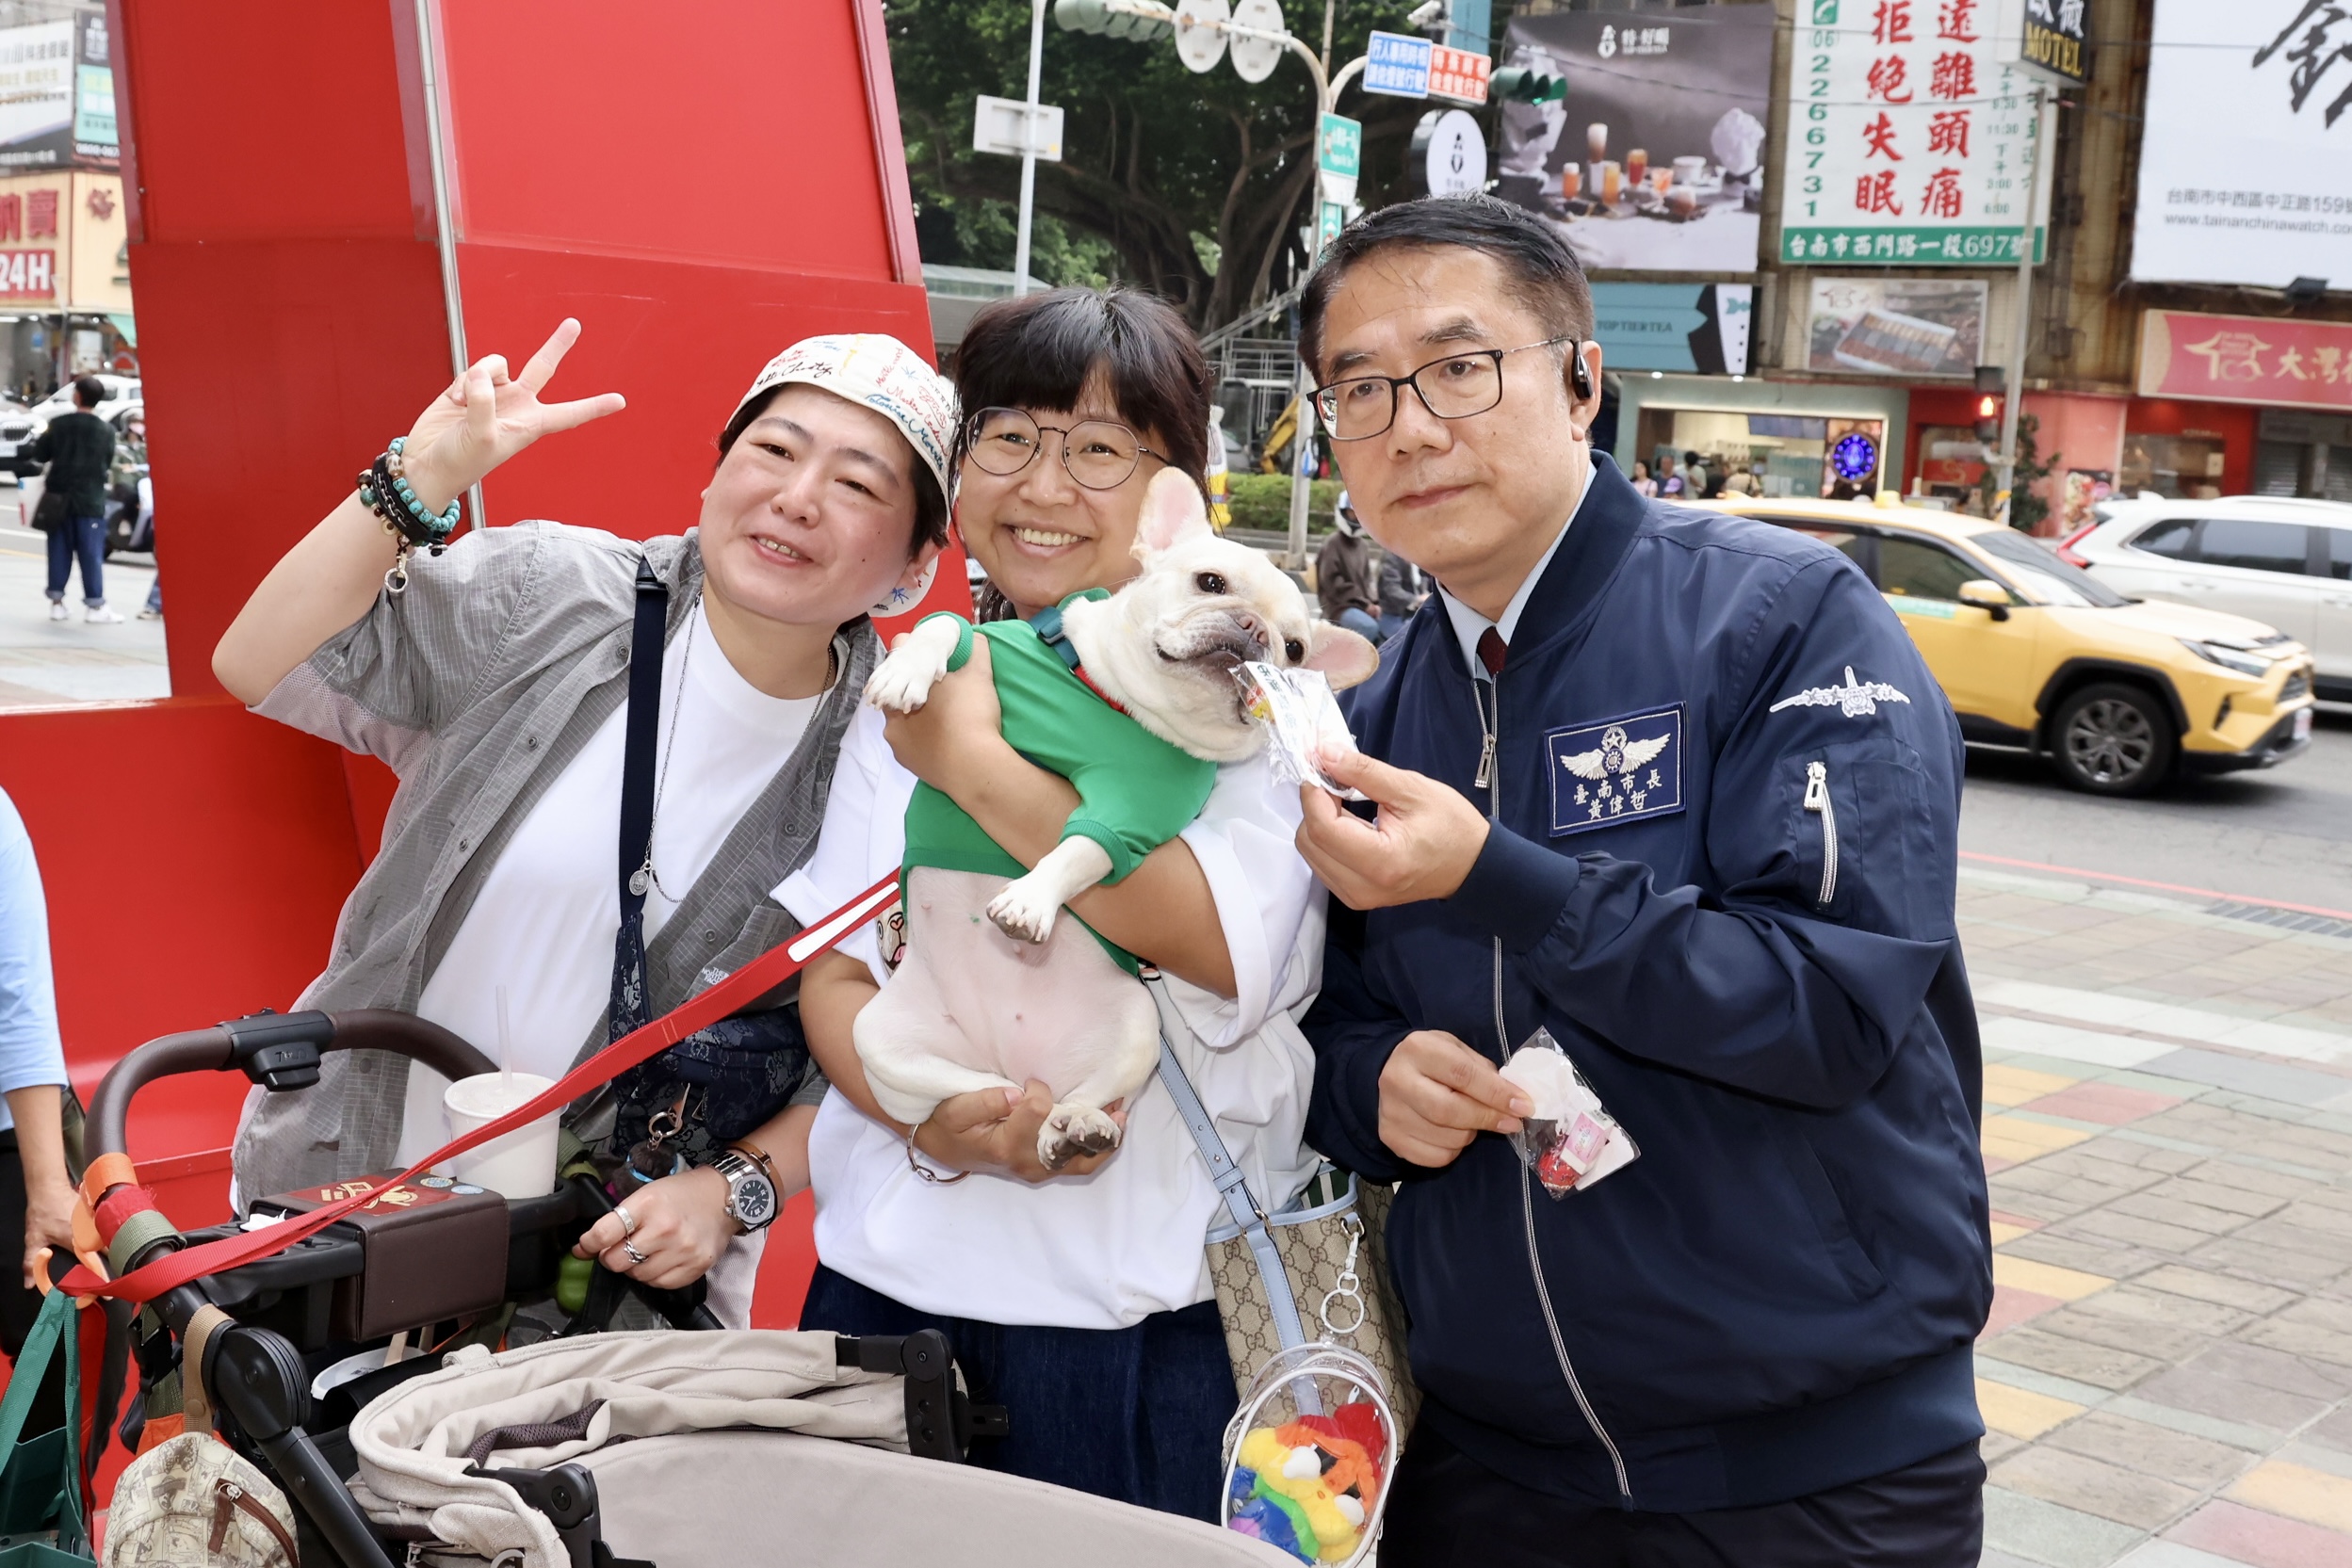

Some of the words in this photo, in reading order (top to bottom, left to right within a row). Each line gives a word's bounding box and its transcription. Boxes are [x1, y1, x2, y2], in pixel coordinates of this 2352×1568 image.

[2024, 21, 2083, 77] MOTEL
[1855, 0, 1914, 217] 拒絕失眠
[1921, 0, 1981, 218] 遠離頭痛
[2164, 214, 2352, 234] www.tainanchinawatch.co
[1574, 768, 1663, 805] 臺南市長
[1588, 789, 1648, 820] 黃偉哲
